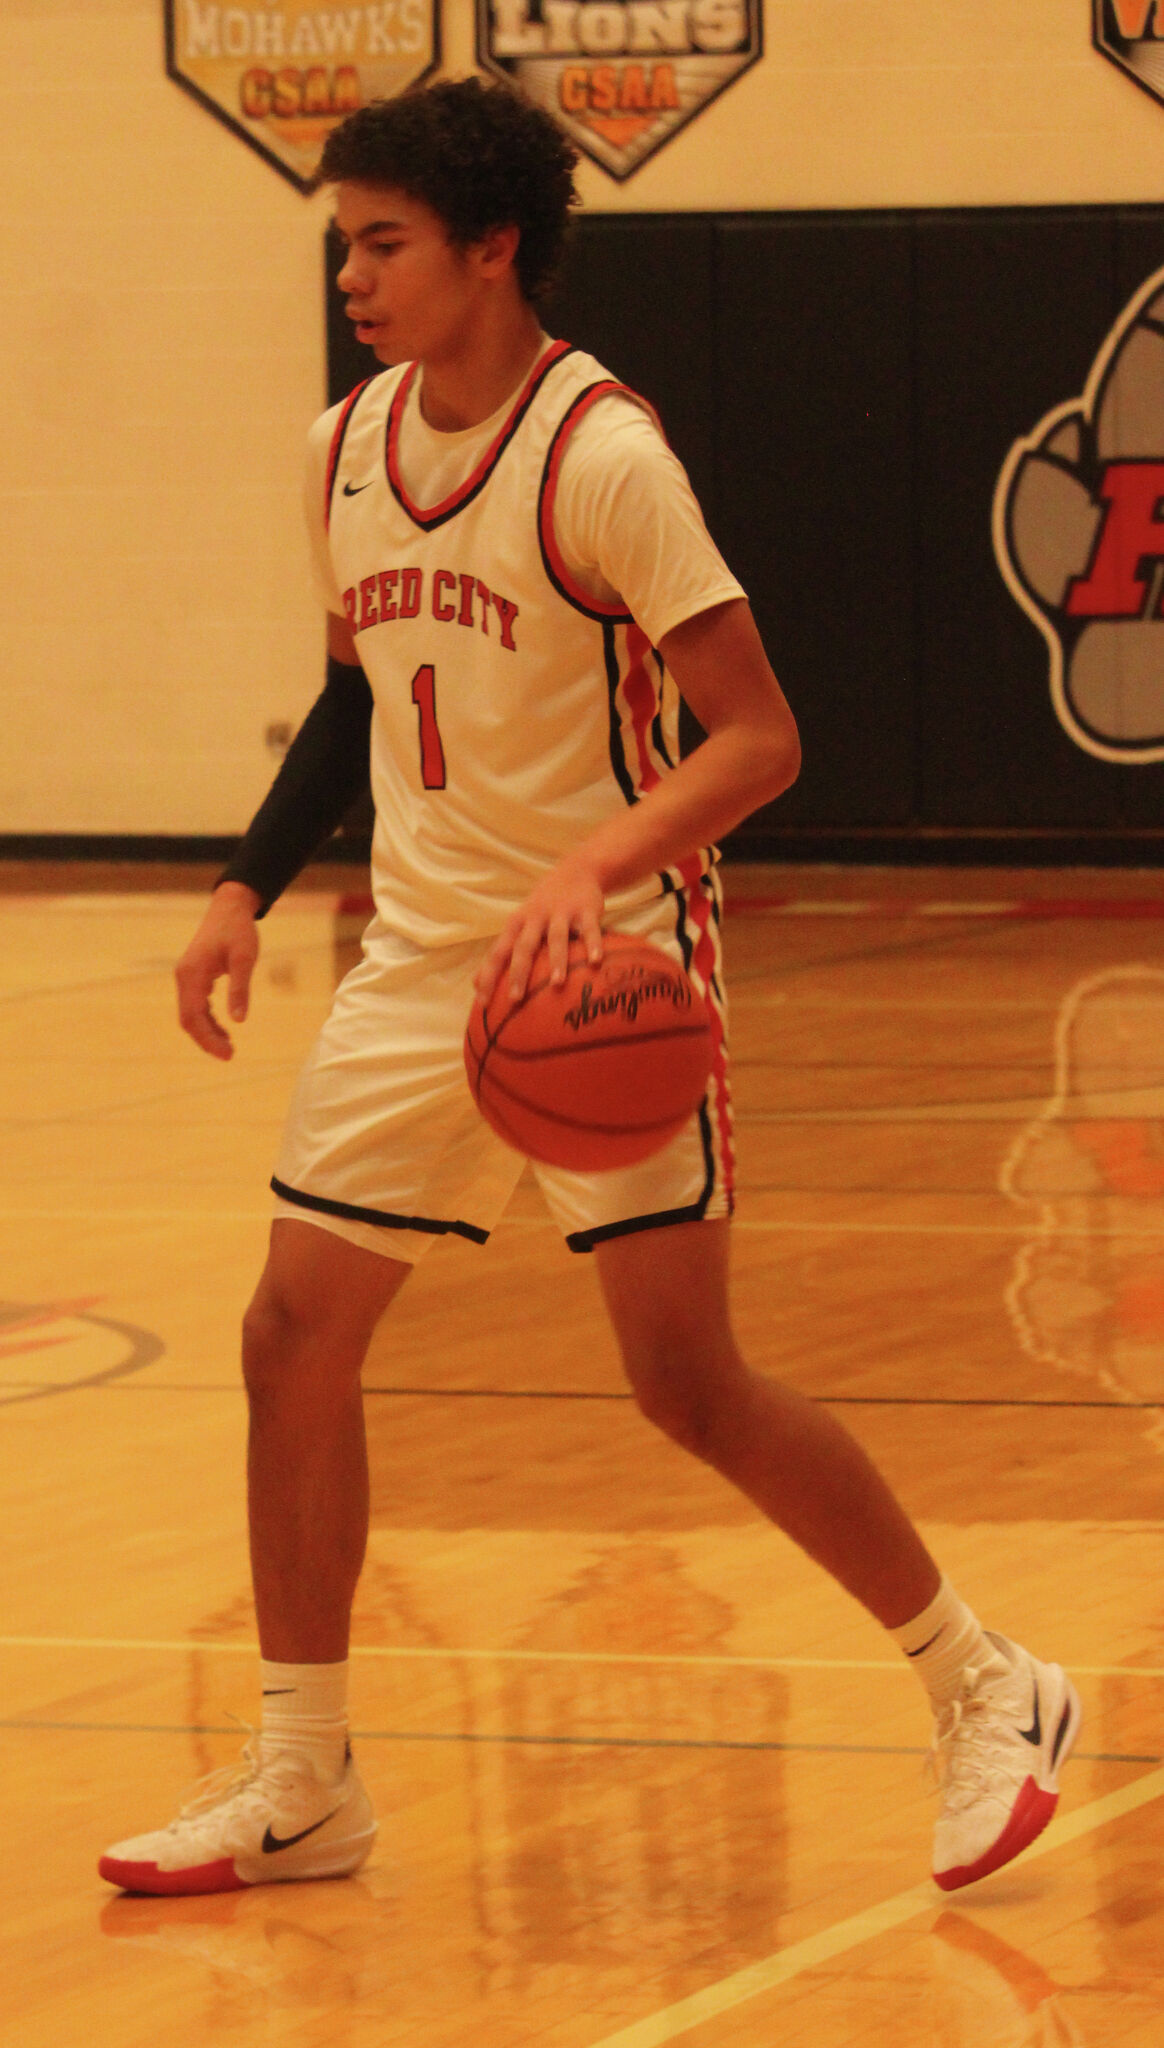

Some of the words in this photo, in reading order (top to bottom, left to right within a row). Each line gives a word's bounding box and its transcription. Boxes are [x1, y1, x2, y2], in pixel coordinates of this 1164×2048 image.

[184, 0, 424, 57] MOHAWKS
[493, 0, 747, 54] LIONS
[240, 65, 361, 119] CSAA
[559, 63, 680, 112] CSAA
[432, 569, 518, 651] CITY
[411, 664, 446, 790] 1
